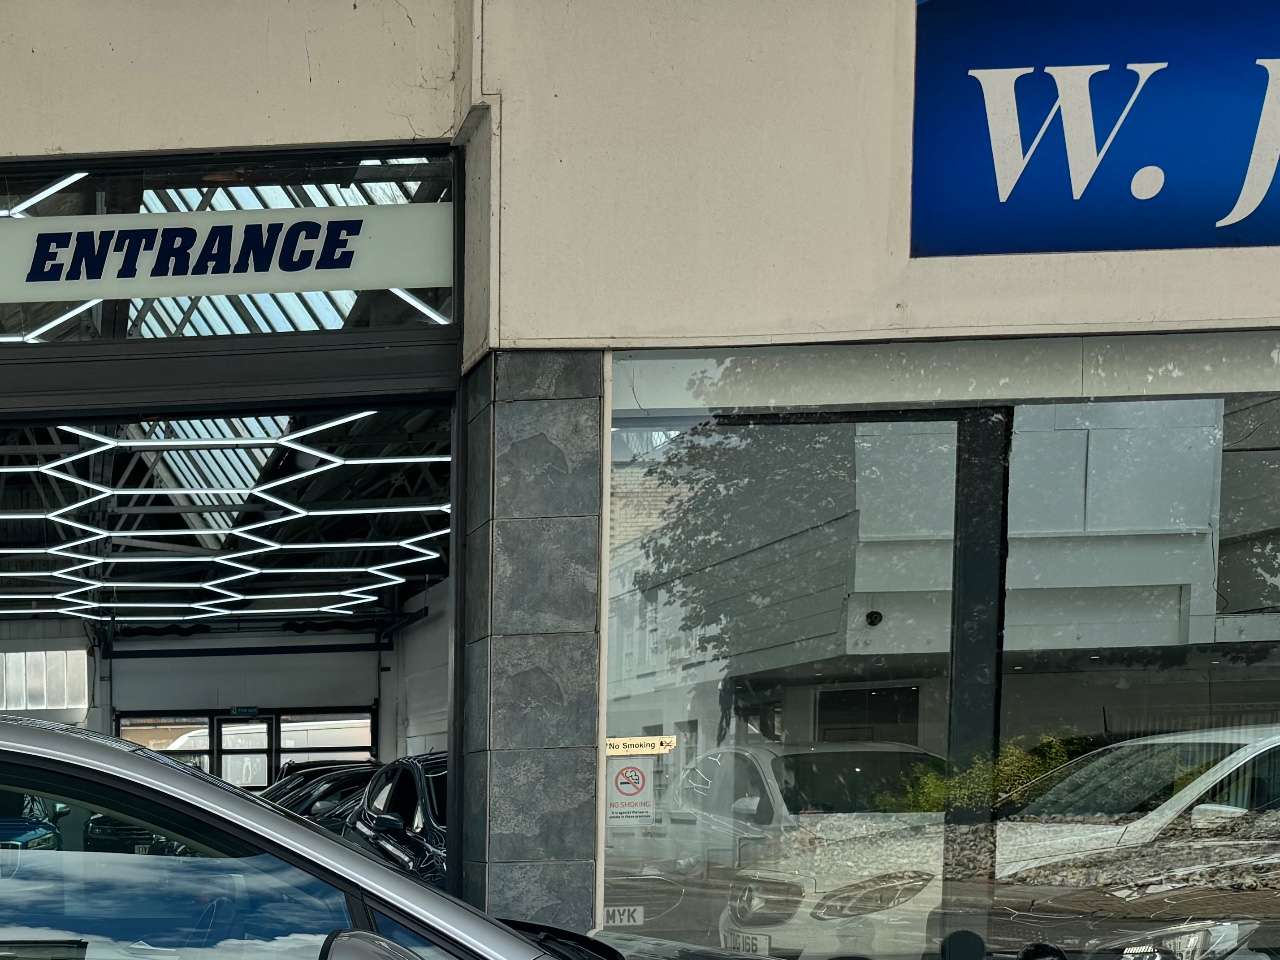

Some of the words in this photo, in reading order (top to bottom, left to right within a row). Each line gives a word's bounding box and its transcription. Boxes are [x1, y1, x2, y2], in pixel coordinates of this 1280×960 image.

[967, 61, 1169, 203] W.
[25, 219, 364, 282] ENTRANCE
[608, 742, 620, 750] No
[622, 742, 656, 750] Smoking
